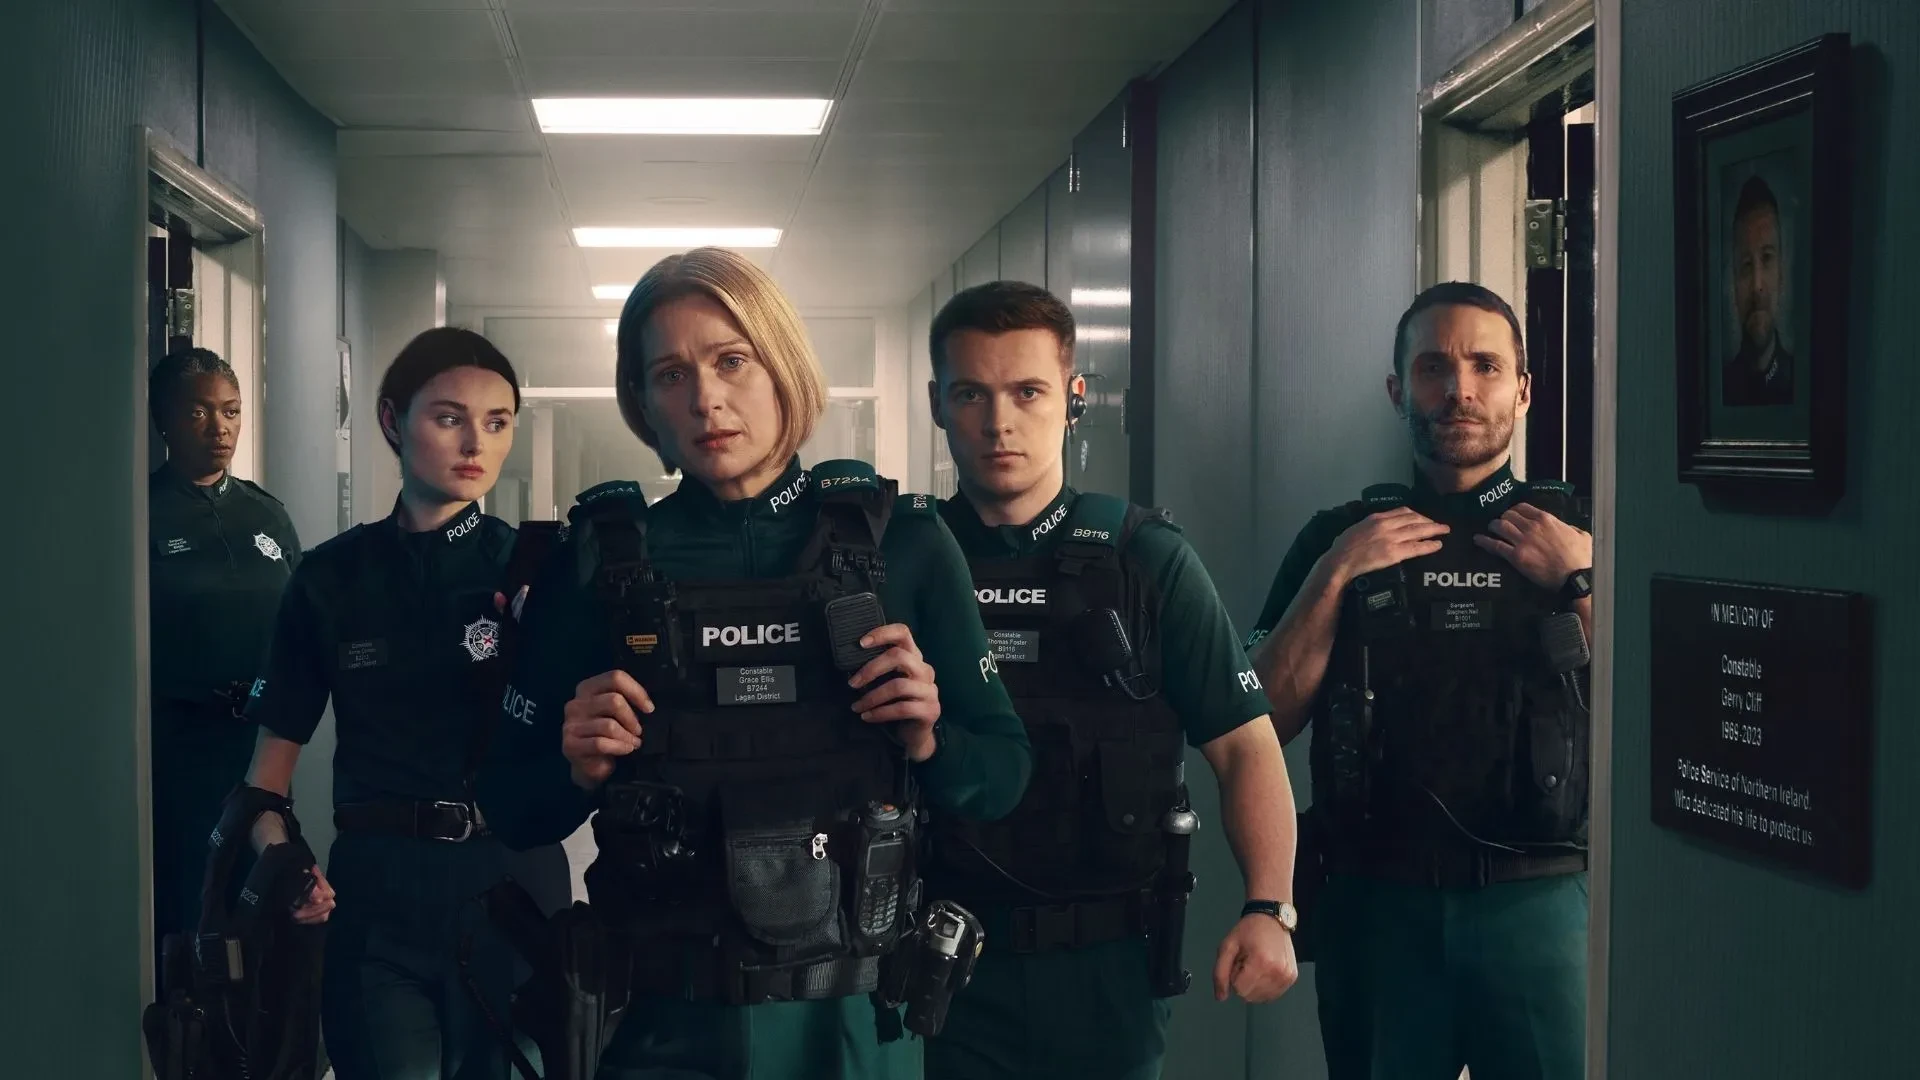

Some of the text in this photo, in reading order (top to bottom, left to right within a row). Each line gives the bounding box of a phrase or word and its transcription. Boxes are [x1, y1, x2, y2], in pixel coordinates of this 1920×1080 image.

[820, 476, 872, 489] B7244
[1479, 478, 1514, 508] POLICE
[446, 512, 480, 543] POLICE
[1031, 503, 1068, 541] POLICE
[1072, 528, 1111, 541] B9116
[1423, 571, 1502, 588] POLICE
[974, 588, 1047, 605] OLICE
[1711, 603, 1720, 622] IN
[1761, 609, 1775, 629] OF
[702, 622, 801, 647] POLICE
[740, 667, 773, 675] Constable
[1721, 654, 1762, 679] Constable
[739, 675, 776, 684] Grace Ellis
[746, 684, 768, 692] B7244
[503, 683, 537, 726] LICE
[735, 692, 781, 703] Lagan District
[1721, 687, 1744, 714] Gerry
[1677, 758, 1700, 782] Police
[1700, 764, 1730, 789] Service
[1731, 771, 1740, 792] of
[1741, 773, 1778, 802] Northern
[1674, 788, 1691, 811] Who
[1692, 793, 1729, 822] dedicated
[1731, 803, 1743, 827] his
[1744, 807, 1758, 831] life
[1759, 813, 1768, 833] to
[1769, 819, 1801, 843] protect
